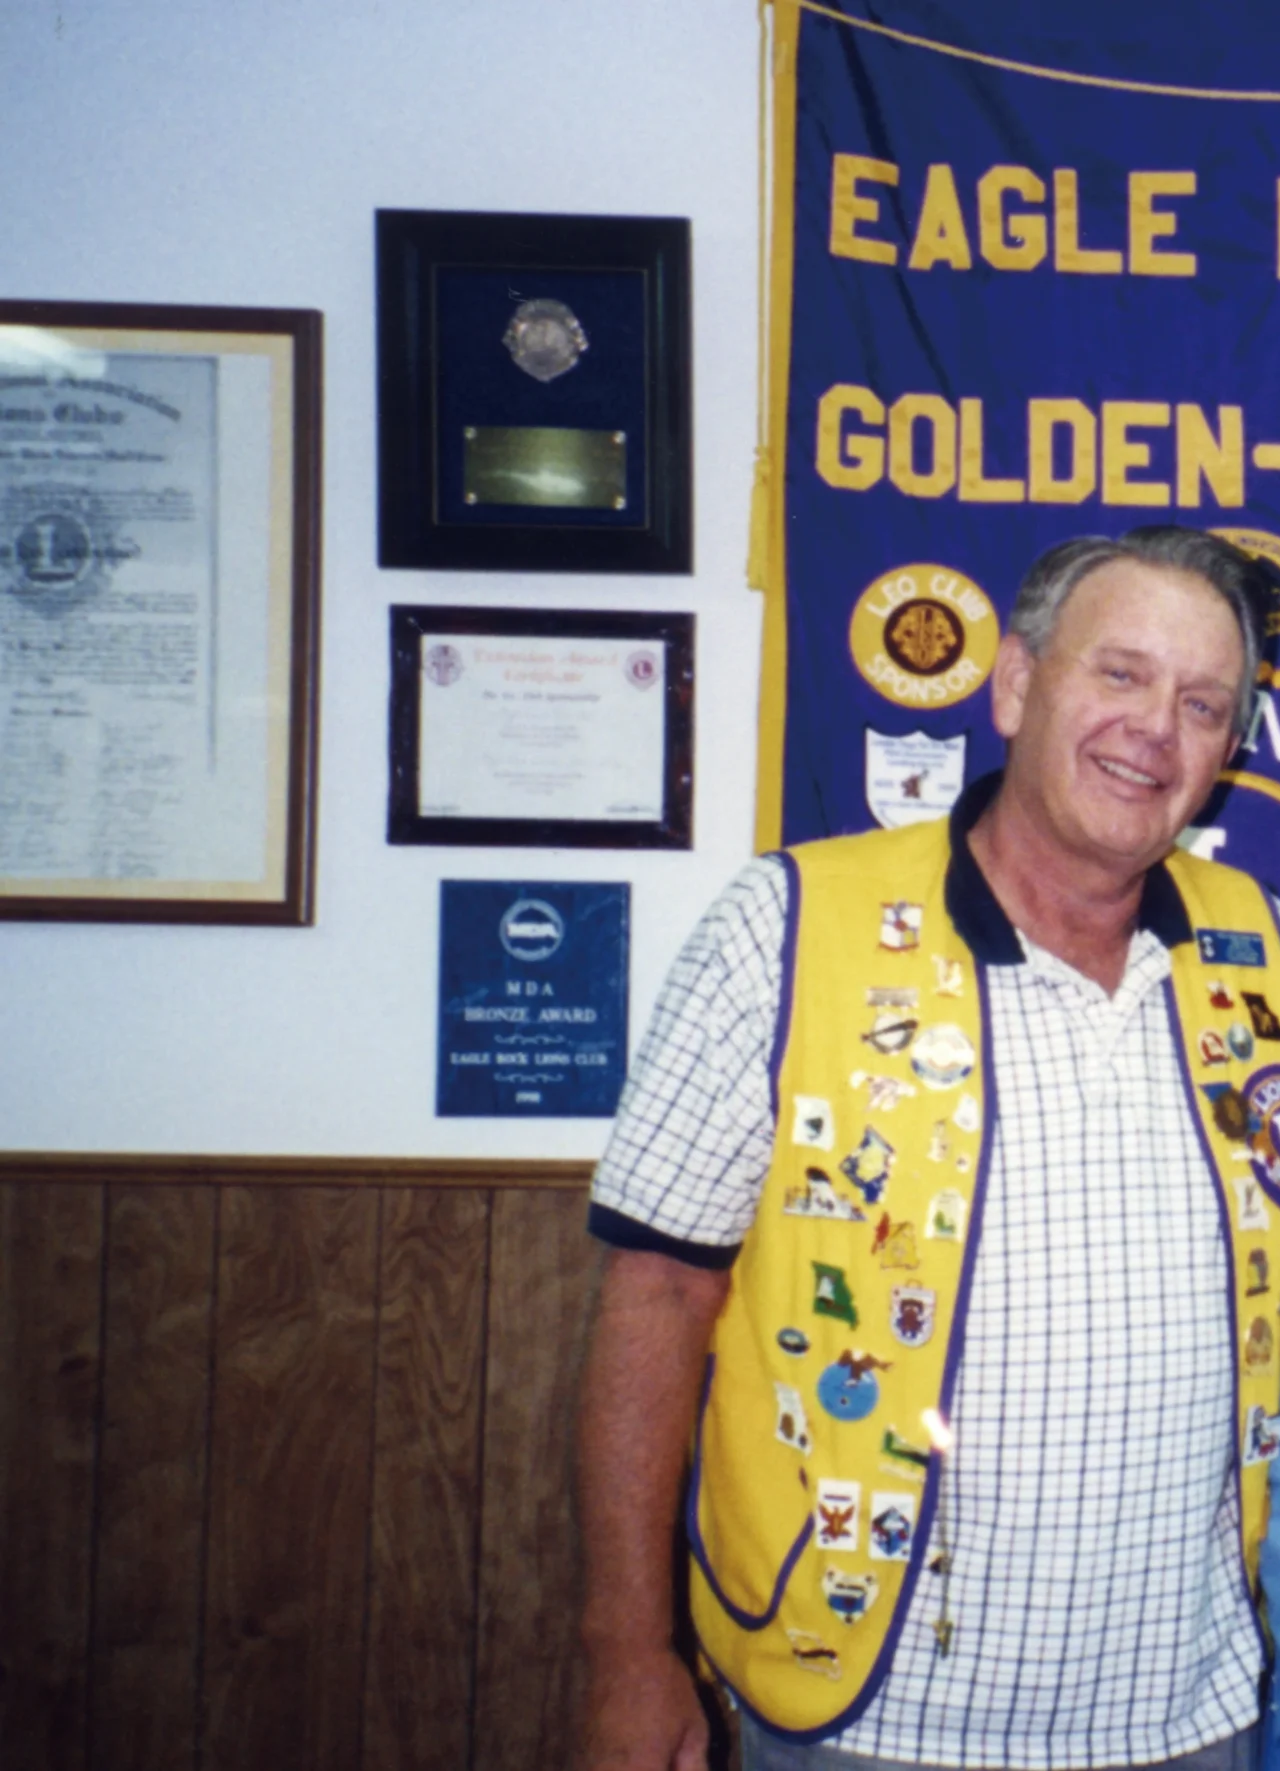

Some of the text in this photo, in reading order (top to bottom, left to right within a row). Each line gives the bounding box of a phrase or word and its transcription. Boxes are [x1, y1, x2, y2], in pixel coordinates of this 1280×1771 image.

[828, 152, 1197, 276] EAGLE
[866, 573, 989, 623] LEO CLUB
[865, 654, 983, 704] SPONSOR
[464, 1007, 597, 1023] BRONZE AWARD
[451, 1052, 490, 1065] EAGLE
[496, 1052, 528, 1065] ROCK
[574, 1053, 608, 1065] CLUB
